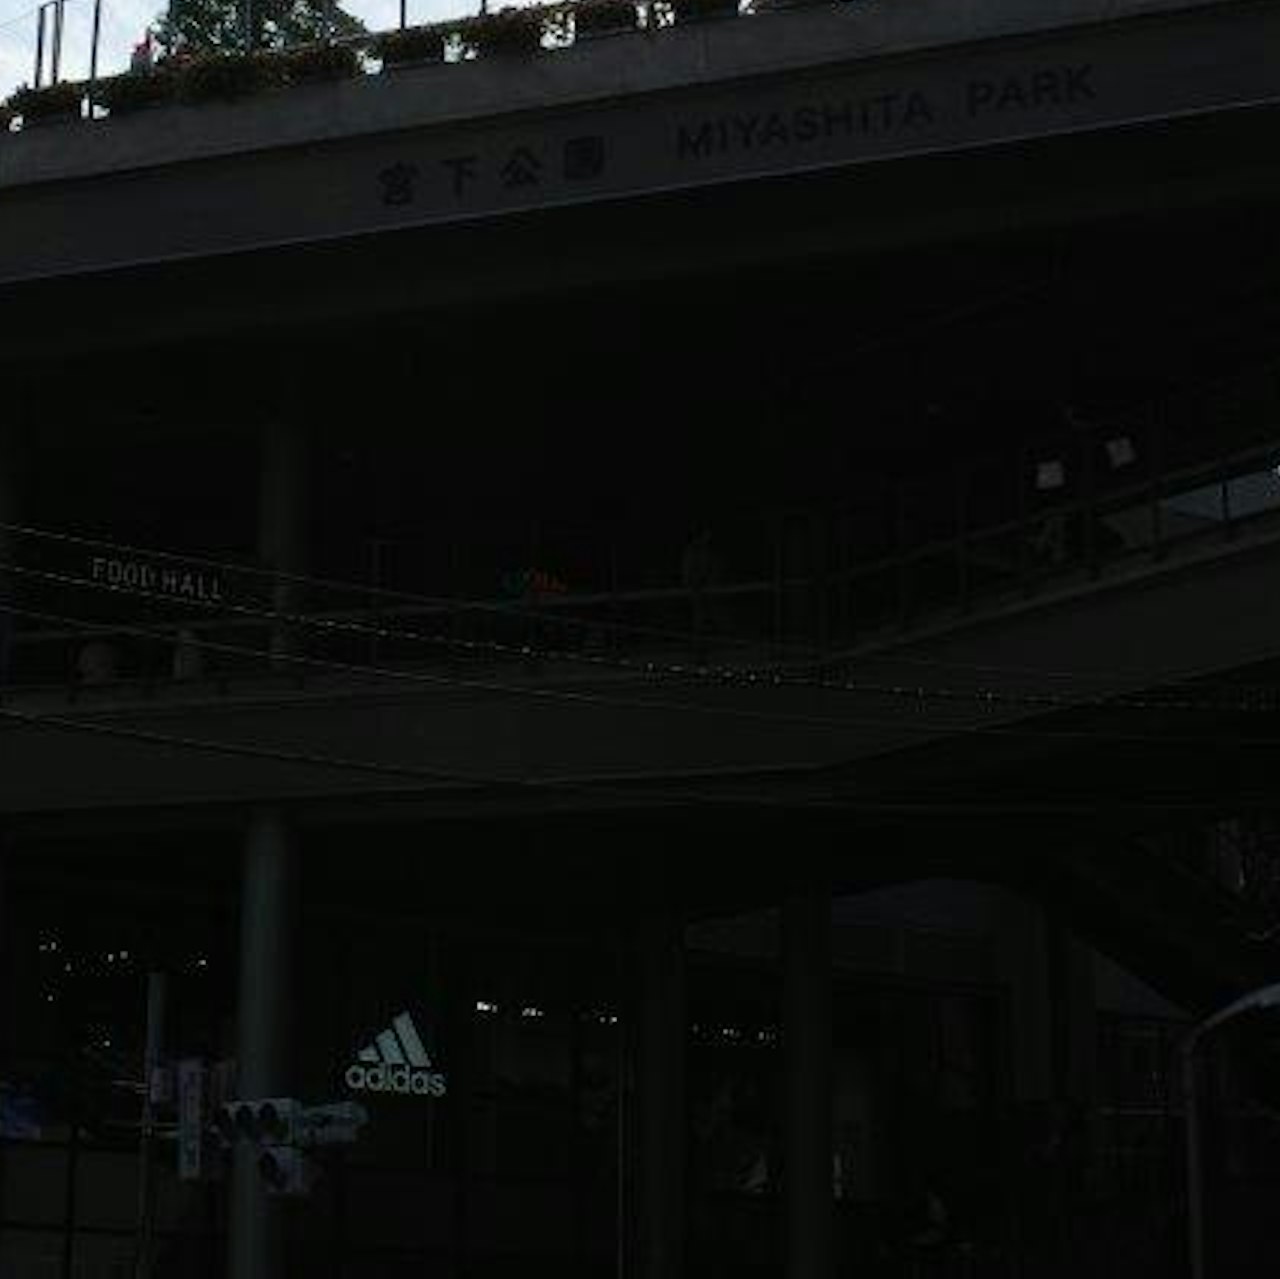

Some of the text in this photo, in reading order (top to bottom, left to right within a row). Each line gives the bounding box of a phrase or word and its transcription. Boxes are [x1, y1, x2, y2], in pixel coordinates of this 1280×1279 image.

[677, 63, 1097, 160] MIYASHITA PARK
[92, 557, 223, 600] FOOD HALL
[345, 1064, 447, 1098] adidas
